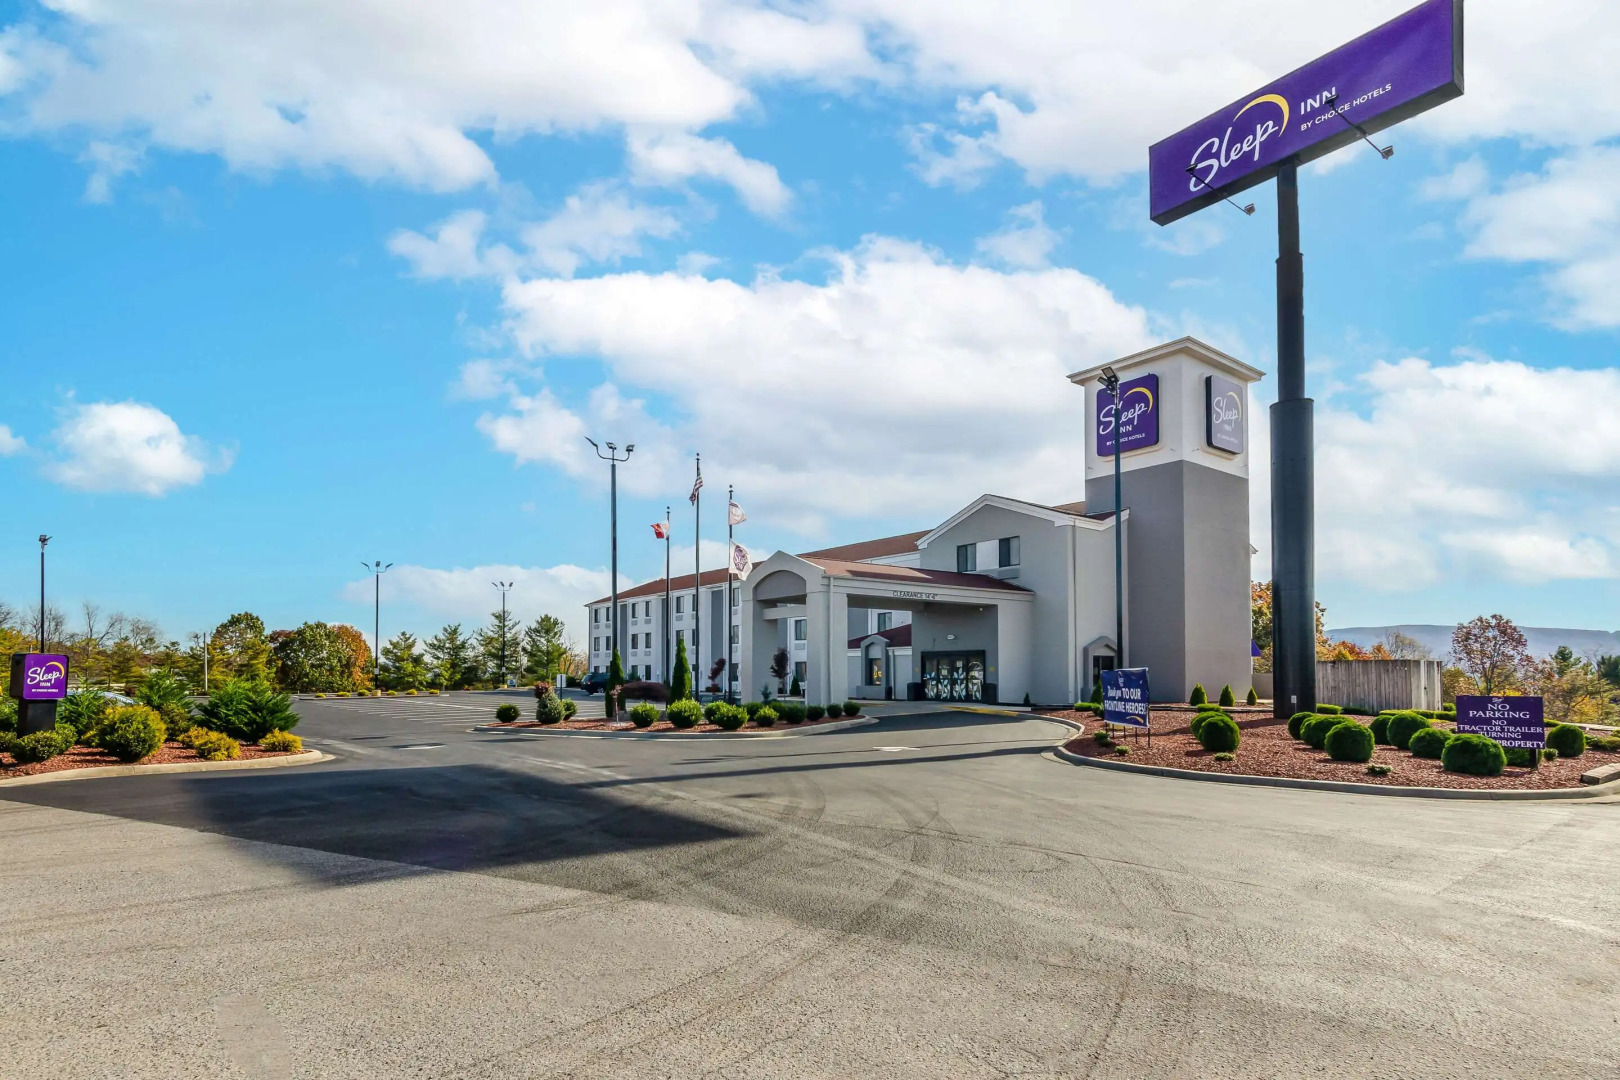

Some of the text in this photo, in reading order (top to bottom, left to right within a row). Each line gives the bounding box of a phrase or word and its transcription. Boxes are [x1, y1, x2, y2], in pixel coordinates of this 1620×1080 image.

[1301, 86, 1336, 115] INN
[1301, 83, 1392, 131] BY CHOICE HOTELS
[1189, 120, 1279, 192] Sleep
[1213, 396, 1239, 429] Sleep
[1119, 424, 1132, 434] NN
[1129, 433, 1146, 441] HOTELS
[26, 666, 61, 685] Sleep
[1122, 688, 1129, 699] TO
[1130, 688, 1141, 700] OUR
[1104, 700, 1125, 712] FRONTLINE
[1487, 703, 1510, 711] NO
[1468, 710, 1530, 719] PARKING
[1458, 724, 1543, 733] TRACTOR TRAILER
[1478, 731, 1522, 739] TURNING
[1497, 739, 1545, 749] PROPERTY
